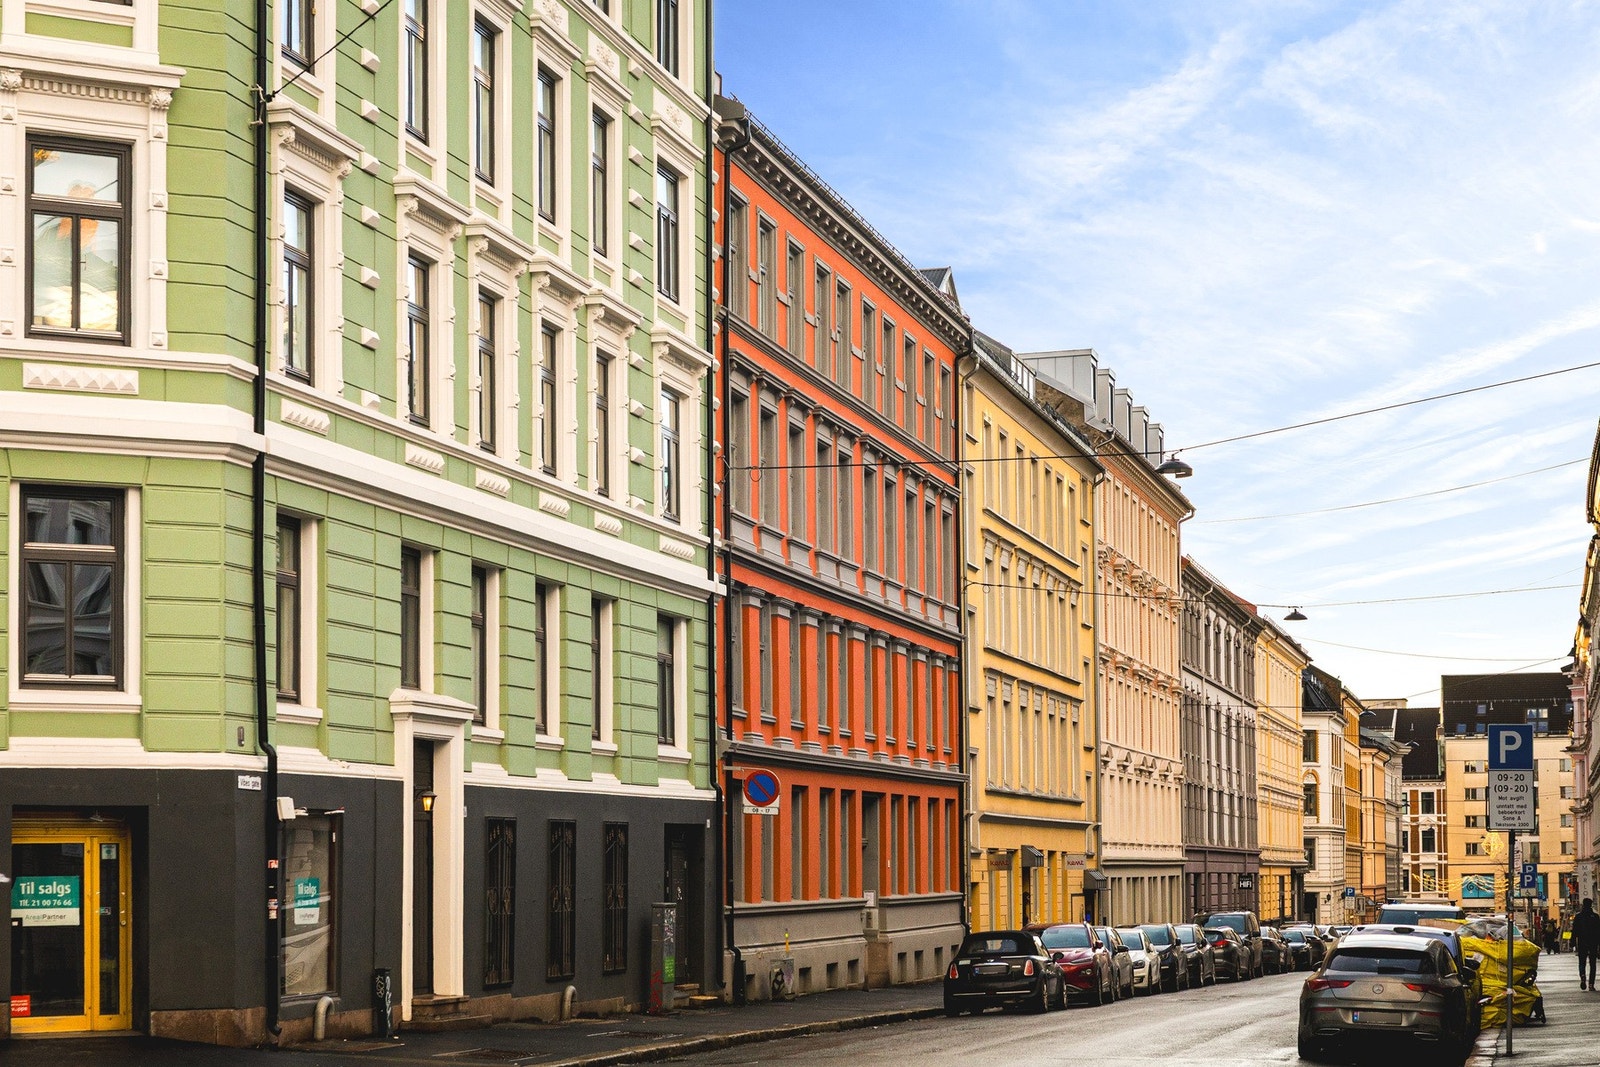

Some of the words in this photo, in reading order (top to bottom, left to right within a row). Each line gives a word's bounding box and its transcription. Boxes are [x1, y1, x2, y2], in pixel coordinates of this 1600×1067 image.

[1500, 731, 1522, 764] P
[1497, 773, 1525, 782] 09-20
[1493, 784, 1529, 793] (09-20)
[1524, 875, 1533, 887] P
[20, 881, 35, 895] Til
[38, 881, 72, 897] salgs
[1347, 888, 1354, 896] P
[31, 899, 40, 907] 21
[42, 899, 51, 907] 00
